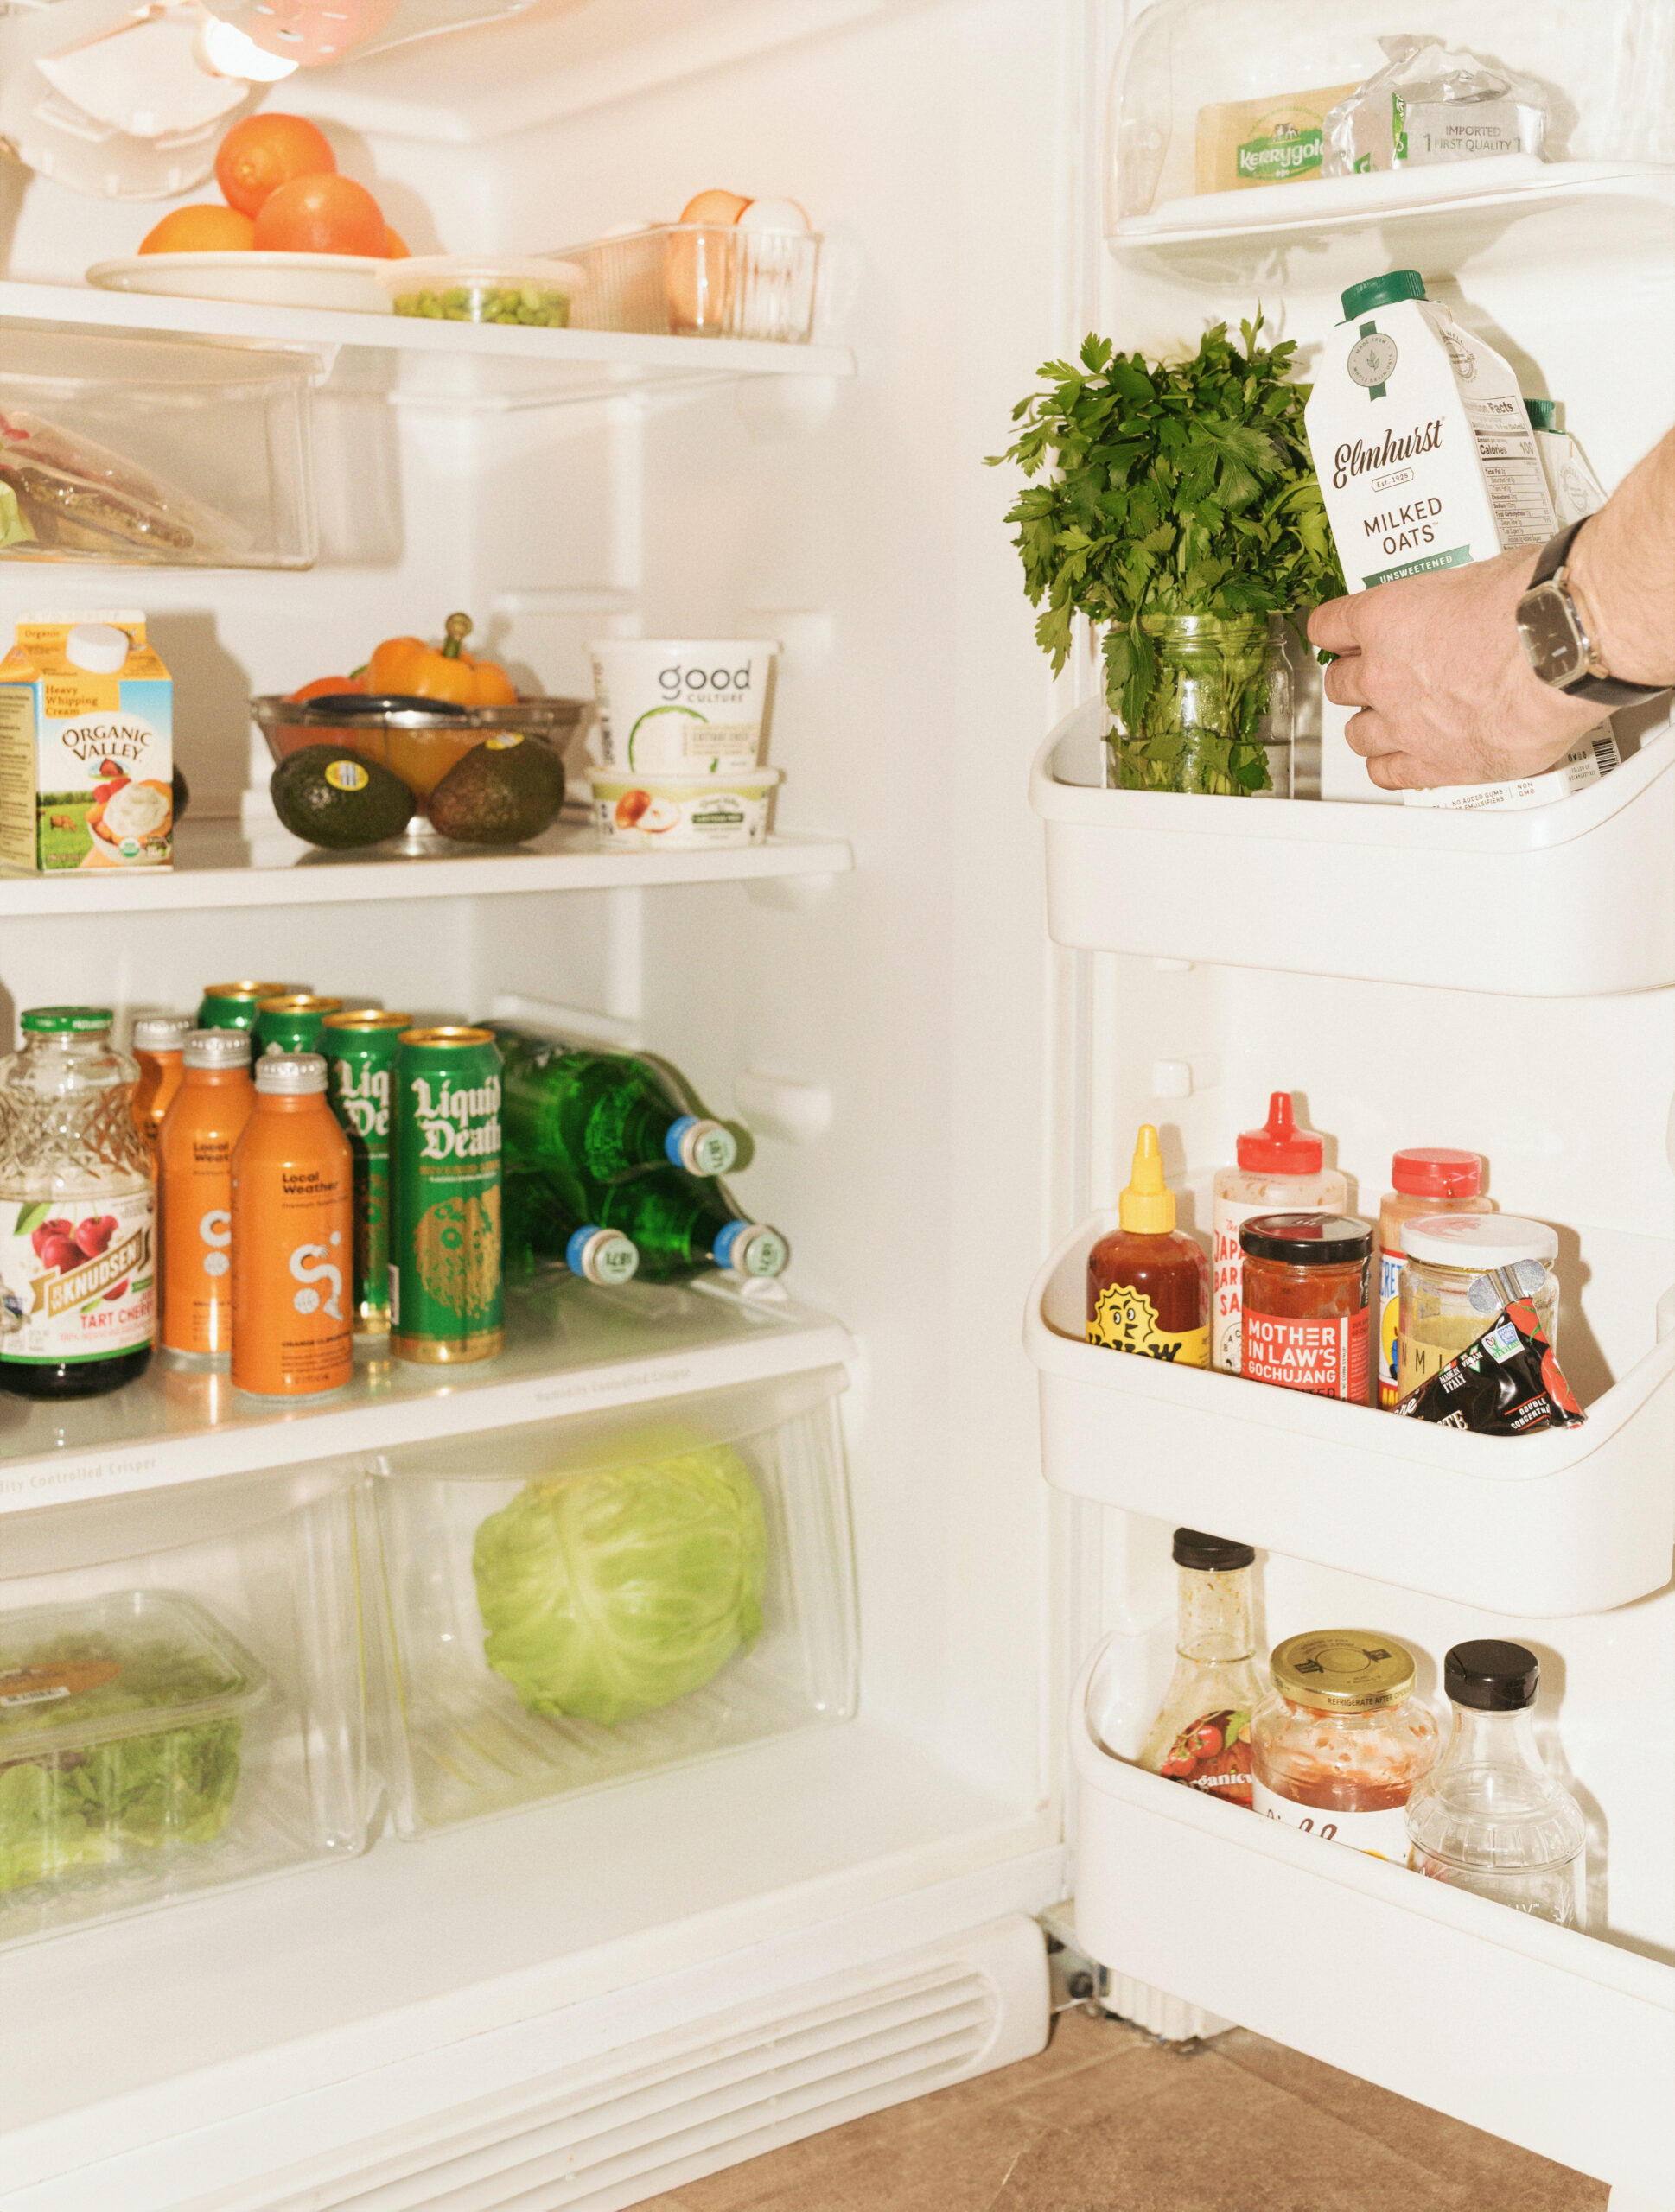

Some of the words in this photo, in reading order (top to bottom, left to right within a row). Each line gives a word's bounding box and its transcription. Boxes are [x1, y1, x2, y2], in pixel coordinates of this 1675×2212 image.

[1445, 125, 1501, 137] IMPORTED
[1435, 138, 1462, 149] FIRST
[1465, 138, 1513, 152] QUALITY
[1487, 401, 1514, 414] Facts
[1333, 418, 1443, 489] Elmhurst
[1479, 444, 1507, 455] Calories
[1519, 441, 1534, 454] 100
[1363, 497, 1443, 537] MILKED
[1383, 524, 1435, 555] OATS
[1379, 555, 1453, 584] UNSWEETENED
[46, 685, 78, 695] Heavy
[659, 659, 752, 701] good
[46, 696, 98, 706] Whipping
[687, 693, 744, 702] CULTURE
[62, 725, 152, 747] ORGANIC
[73, 742, 143, 761] VALLEY
[1462, 794, 1483, 804] ADDED
[1485, 789, 1504, 798] GUMS
[1519, 788, 1535, 797] GMO
[1464, 797, 1505, 810] EMULSIFIERS
[334, 1059, 389, 1109] Liq
[411, 1074, 501, 1130] Liquid
[343, 1099, 389, 1137] De
[194, 1141, 229, 1151] Local
[194, 1153, 229, 1162] Weat
[283, 1171, 320, 1183] Local
[283, 1181, 339, 1194] Weather
[1213, 1229, 1247, 1263] JAPA
[63, 1241, 138, 1303] KNUDSEN
[1213, 1266, 1243, 1294] BAR
[80, 1312, 113, 1329] TART
[118, 1300, 153, 1324] CHERR
[1220, 1292, 1242, 1316] SA
[1249, 1317, 1336, 1347] MOTHER
[1249, 1338, 1264, 1362] IN
[1268, 1344, 1336, 1368] LAW'S
[1249, 1360, 1336, 1384] GOCHUJANG
[1438, 1369, 1455, 1384] MADE
[1443, 1373, 1467, 1394] ITALY
[1519, 1397, 1547, 1416] DOUBLE
[29, 1465, 103, 1488] Controlled
[109, 1457, 157, 1475] Crisper
[1327, 1697, 1373, 1707] REFRIGERATE
[1374, 1694, 1393, 1704] AFTER
